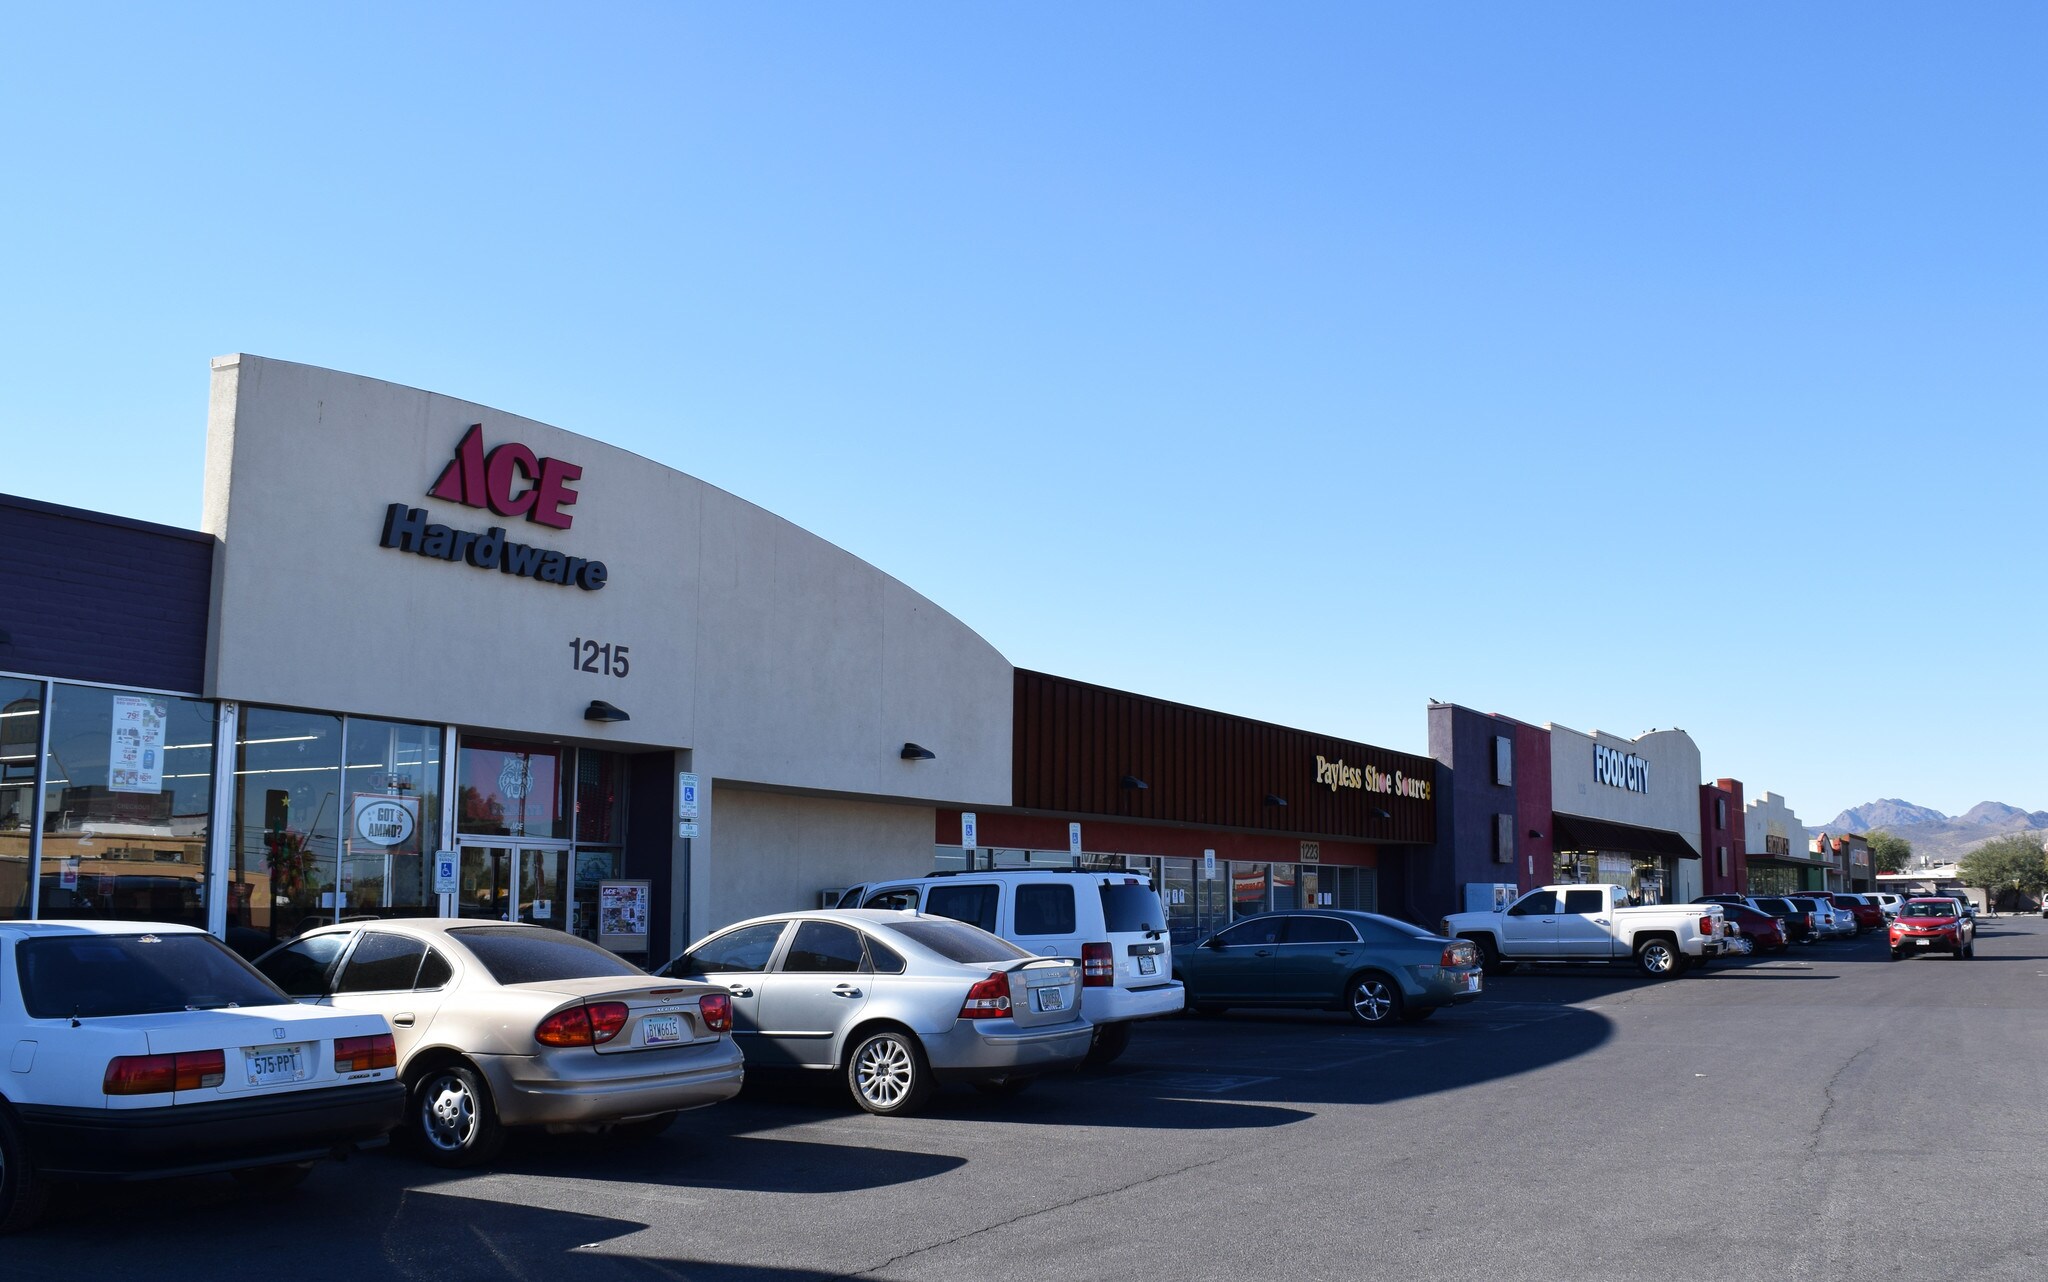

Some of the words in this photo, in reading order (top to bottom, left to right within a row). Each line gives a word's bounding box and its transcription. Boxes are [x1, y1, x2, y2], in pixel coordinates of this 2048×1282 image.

[426, 423, 583, 530] ACE
[379, 502, 608, 591] Hardware
[569, 637, 630, 678] 1215
[1316, 755, 1362, 792] Payless
[1365, 764, 1392, 794] Shoe
[1395, 770, 1431, 800] Source
[1593, 743, 1626, 788] FOOD
[1626, 753, 1650, 794] CITY
[368, 823, 403, 838] AMMO?
[377, 808, 395, 822] GOT
[1301, 844, 1318, 860] 1223
